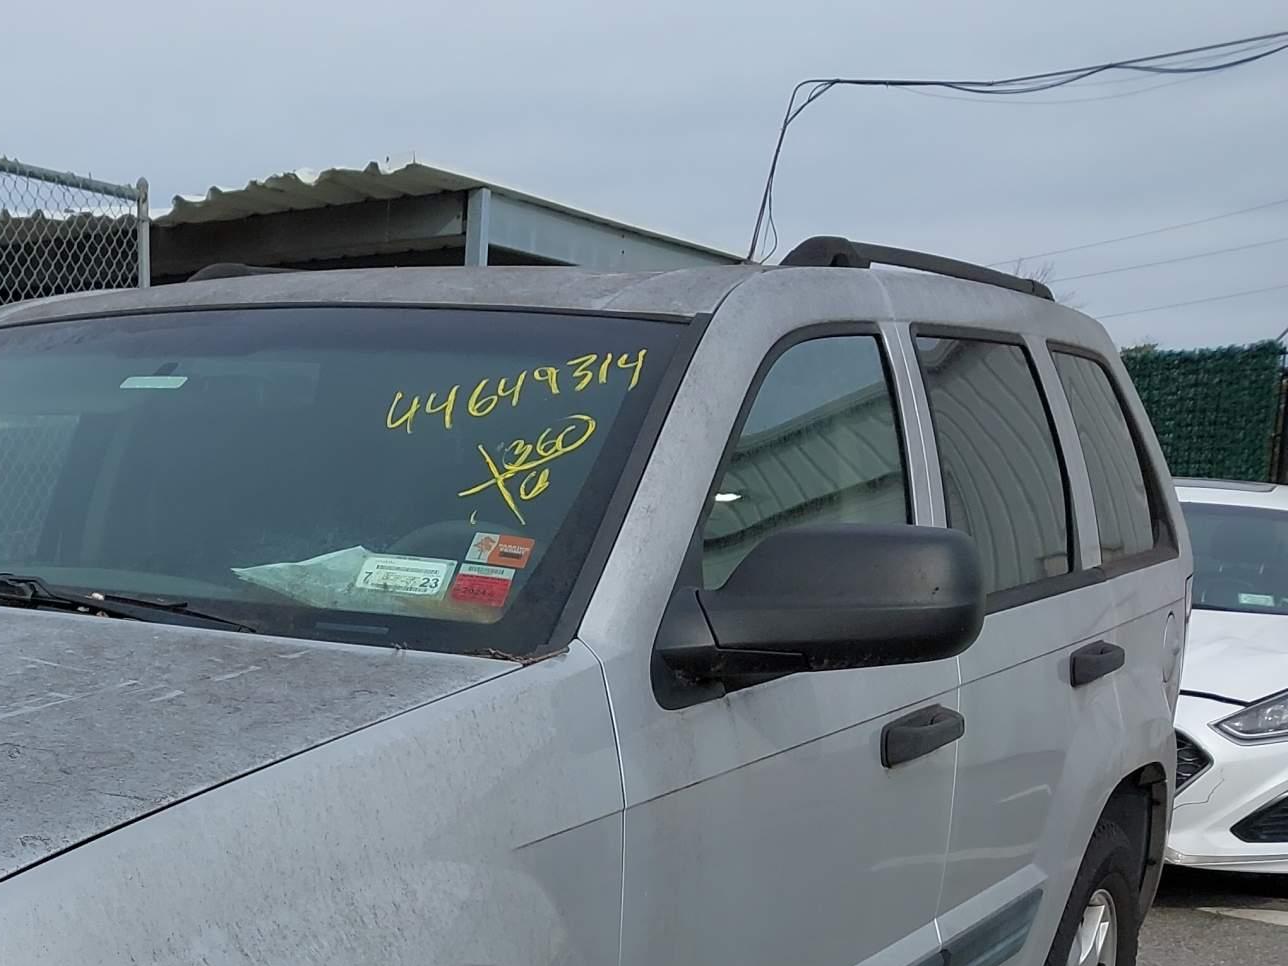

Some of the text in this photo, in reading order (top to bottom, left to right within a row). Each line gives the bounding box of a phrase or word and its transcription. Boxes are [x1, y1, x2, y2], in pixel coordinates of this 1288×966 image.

[385, 348, 649, 434] 44649314
[363, 571, 373, 583] 7
[419, 577, 440, 589] 23
